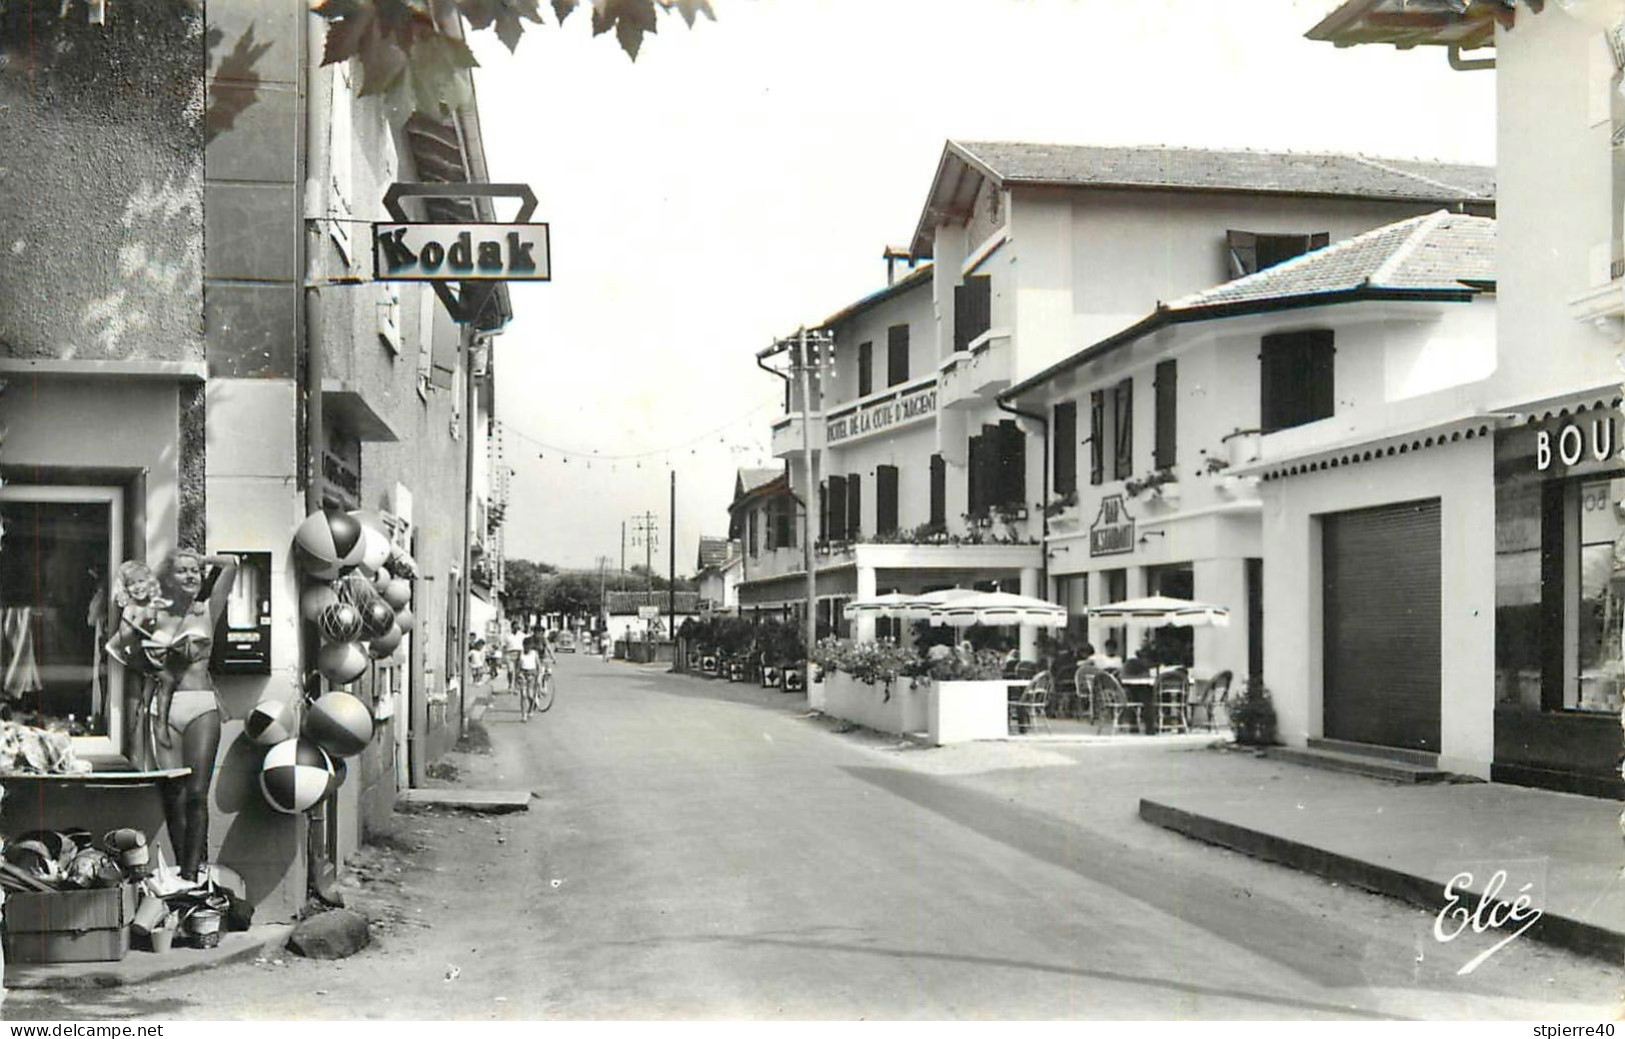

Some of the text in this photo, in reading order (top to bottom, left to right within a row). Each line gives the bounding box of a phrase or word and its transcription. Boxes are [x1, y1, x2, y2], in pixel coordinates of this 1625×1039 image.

[379, 227, 536, 274] Kodak
[850, 415, 859, 435] DE
[861, 412, 871, 432] LA
